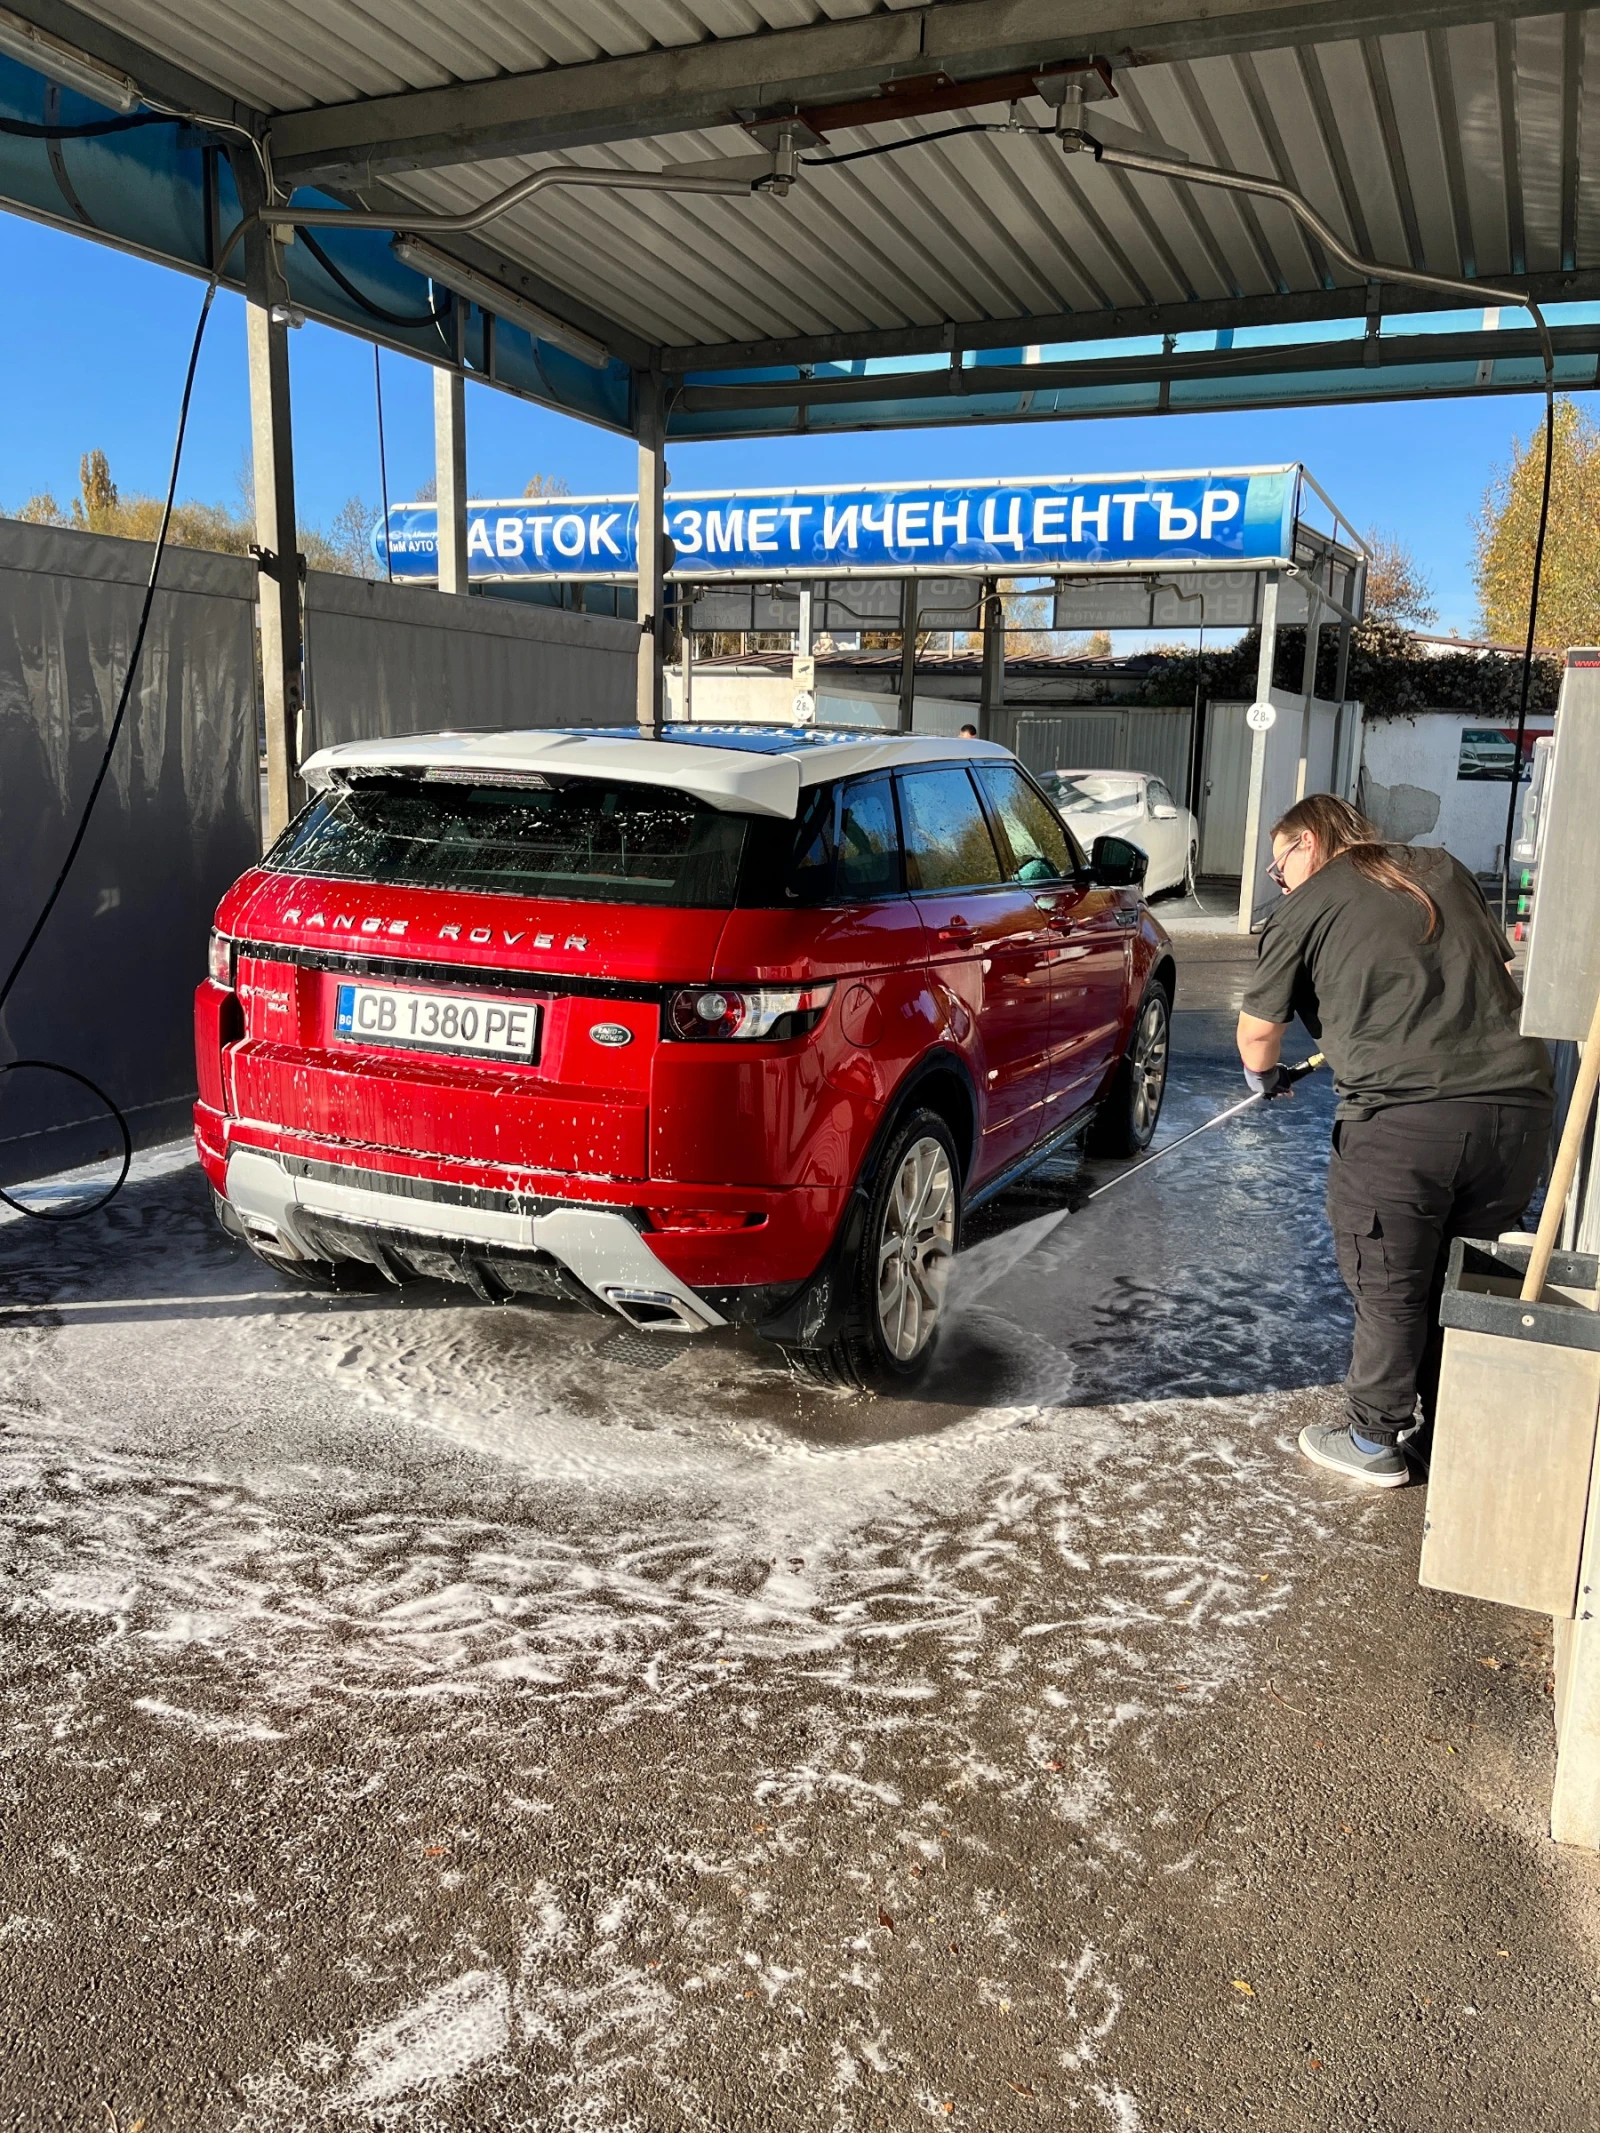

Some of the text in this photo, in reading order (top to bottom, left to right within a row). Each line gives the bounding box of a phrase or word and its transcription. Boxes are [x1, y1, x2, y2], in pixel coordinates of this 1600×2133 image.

[467, 490, 1239, 557] АВТОКЗМЕТИЧЕН ЦЕНТЪР
[409, 541, 433, 552] АУТО
[282, 908, 589, 951] RANGE ROVER
[338, 1014, 352, 1026] BG
[358, 994, 529, 1048] CB 1380 PE
